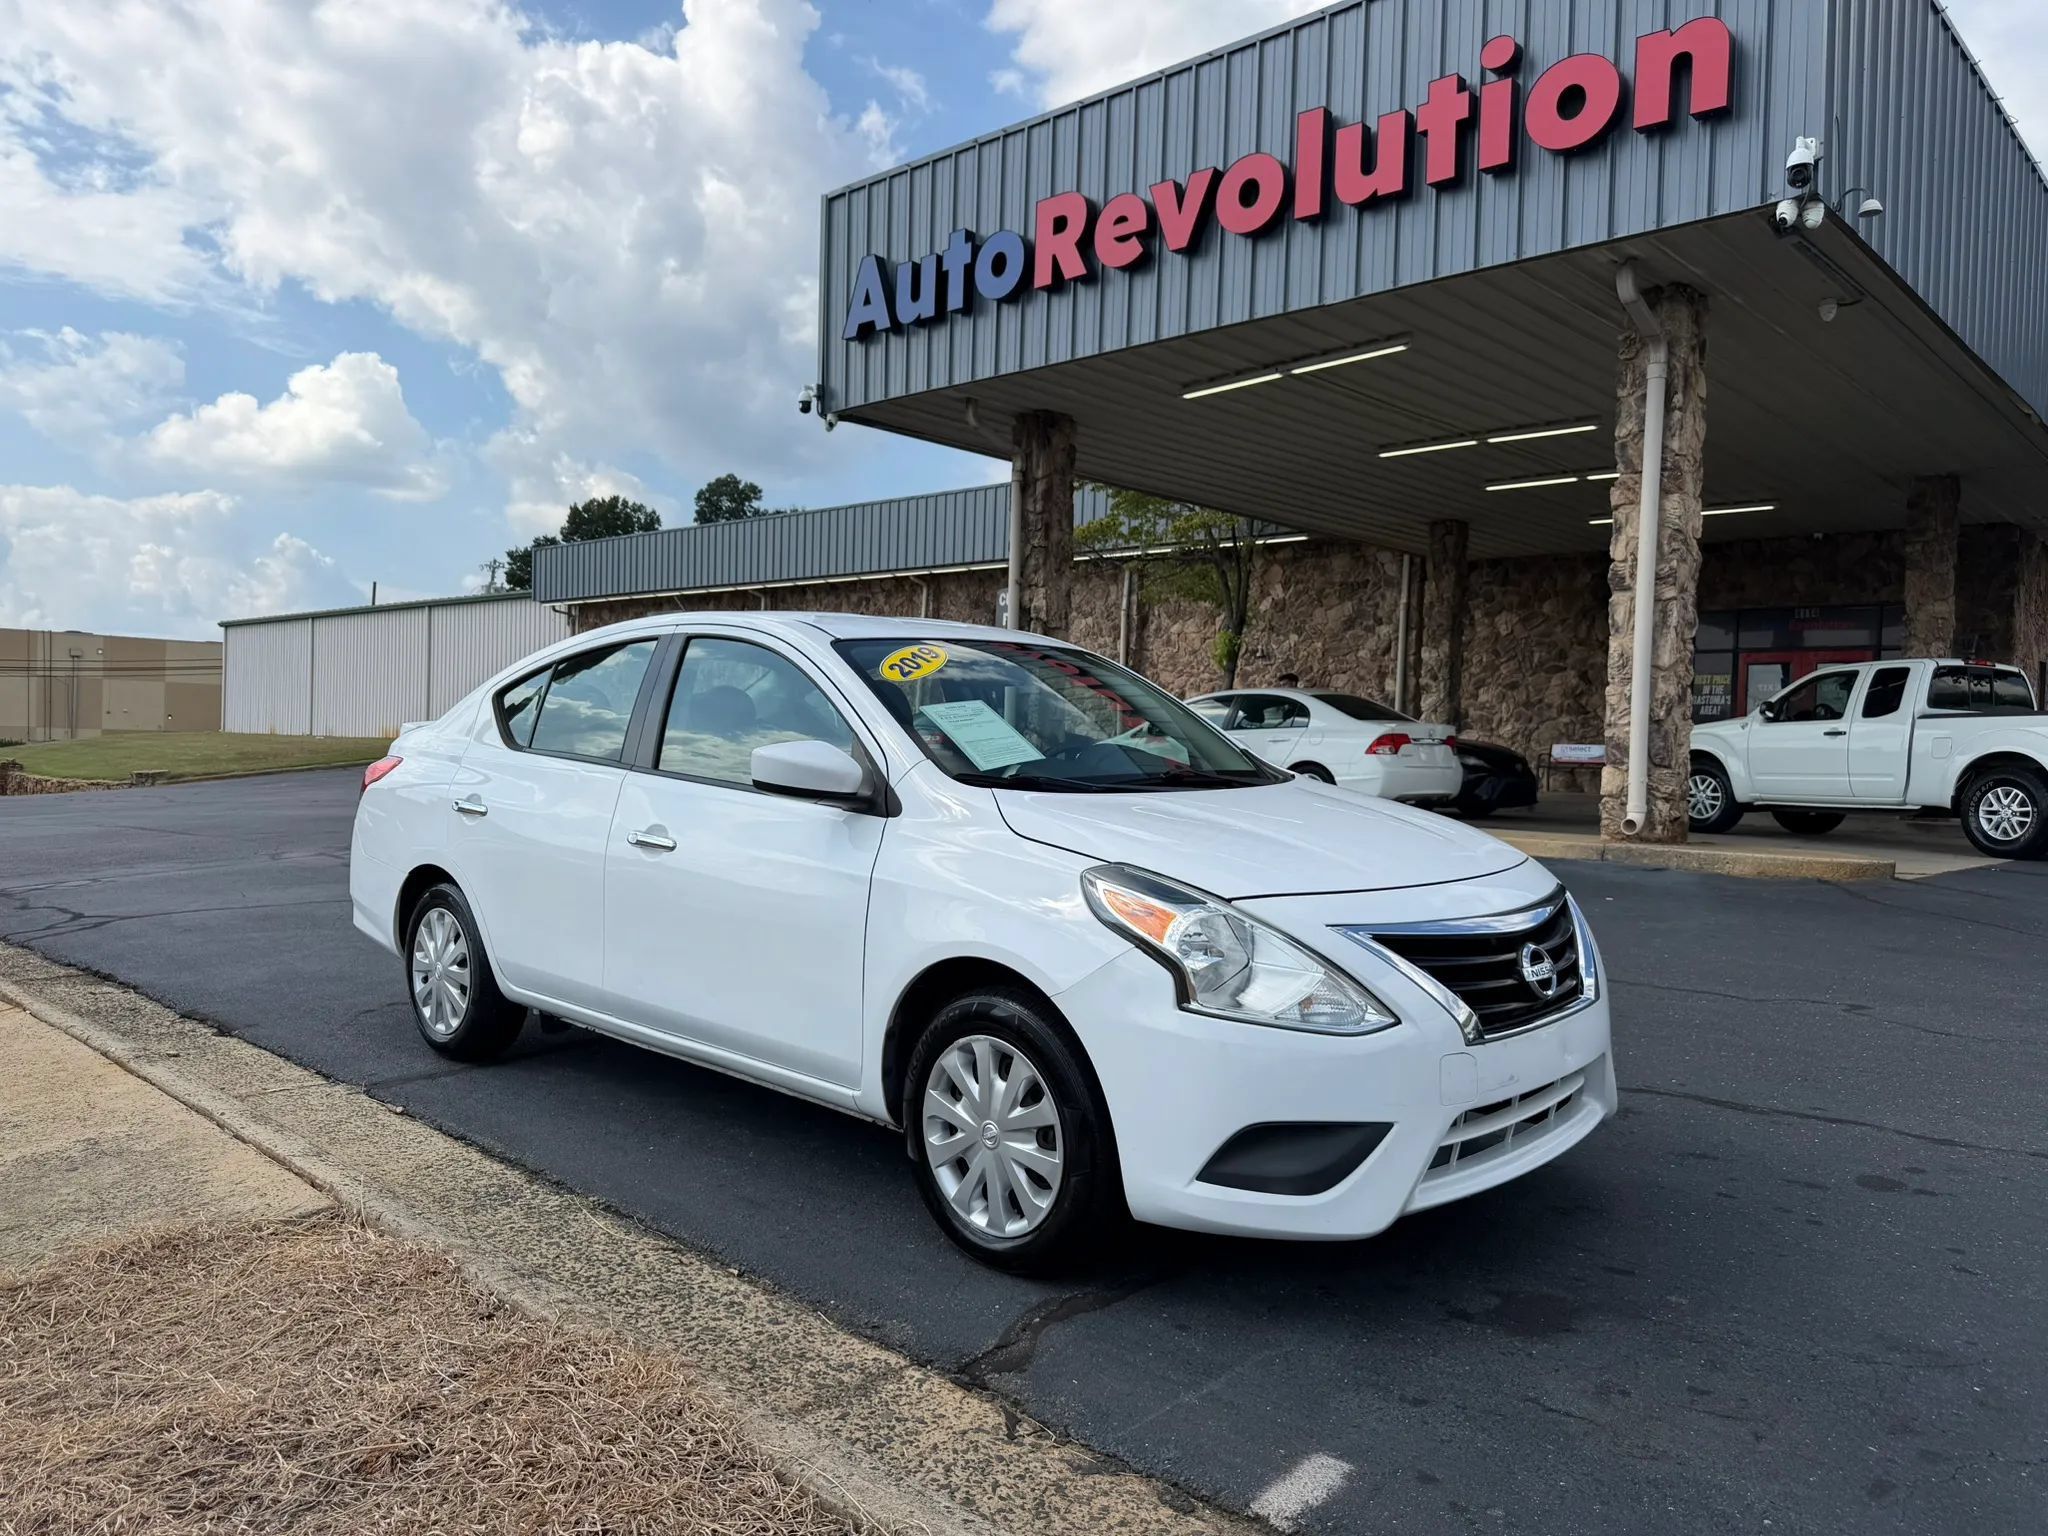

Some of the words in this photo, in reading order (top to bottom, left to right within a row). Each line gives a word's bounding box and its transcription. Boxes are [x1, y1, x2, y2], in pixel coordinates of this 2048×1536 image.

[888, 647, 939, 678] 2019
[1702, 685, 1710, 694] IN
[1711, 685, 1724, 694] THE
